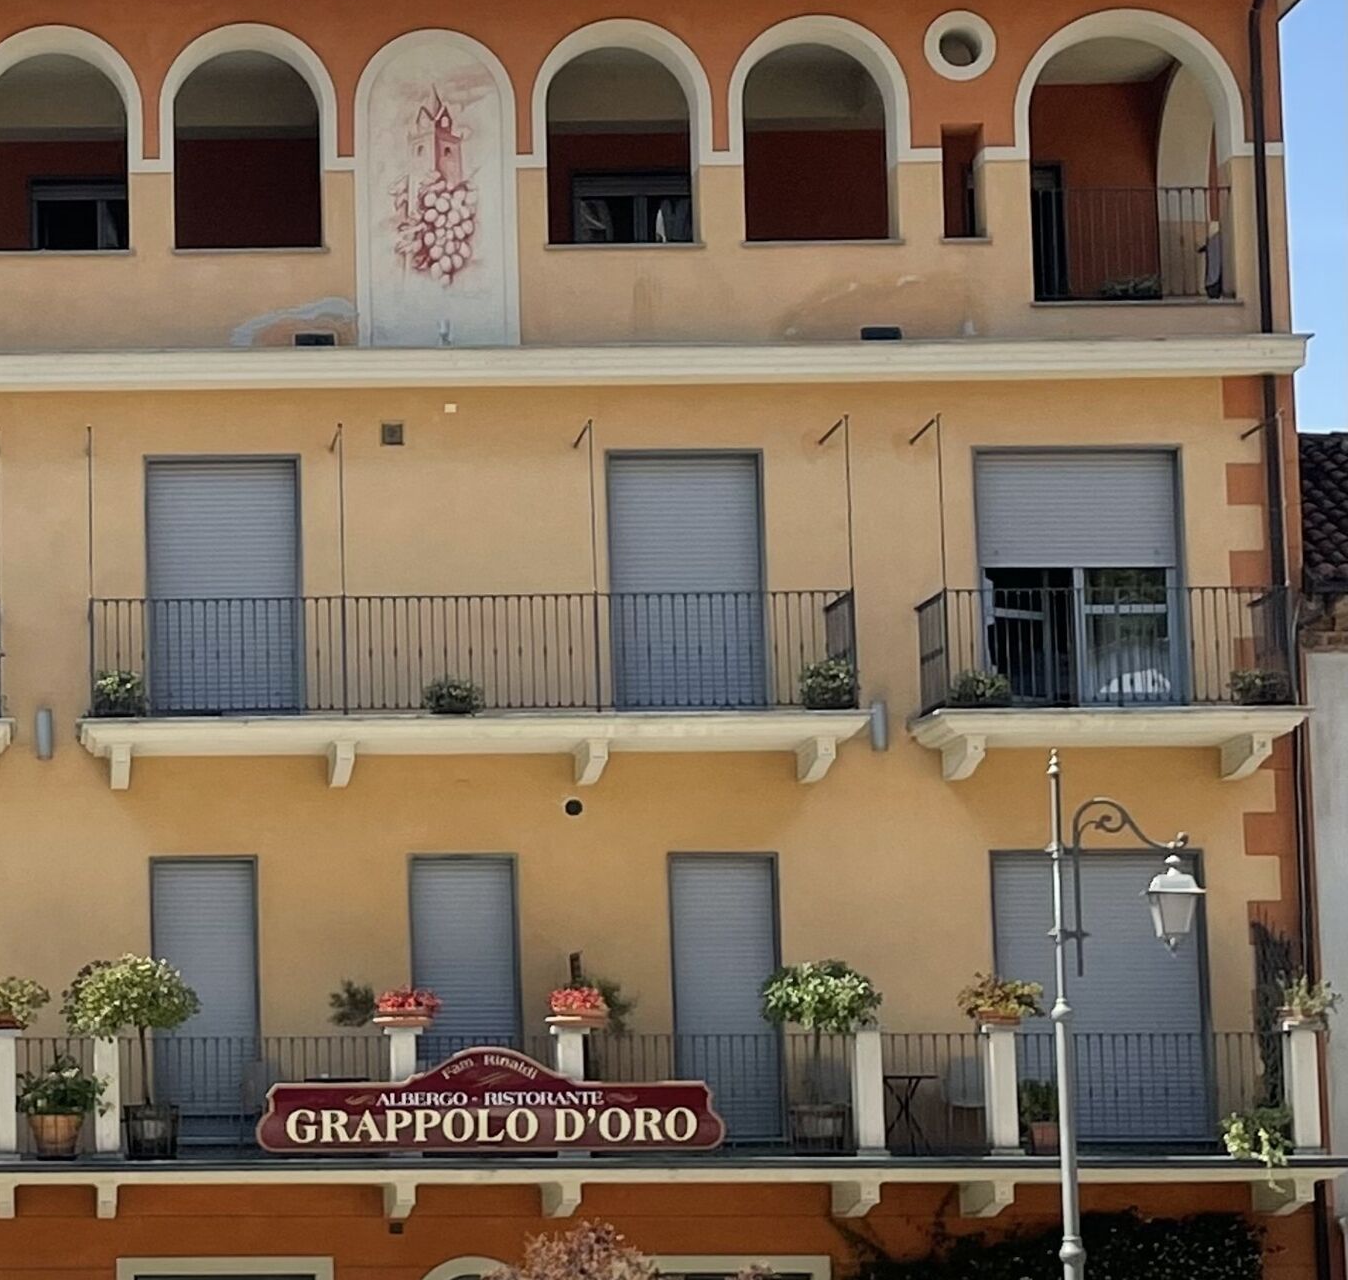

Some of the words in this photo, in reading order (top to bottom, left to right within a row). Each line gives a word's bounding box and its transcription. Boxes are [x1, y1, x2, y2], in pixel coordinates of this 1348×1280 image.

[484, 1054, 539, 1080] Rinaldi
[376, 1091, 468, 1107] ALBERGO
[484, 1090, 605, 1107] RISTORANTE
[285, 1108, 539, 1144] GRAPPOLO
[554, 1107, 698, 1143] D'ORO
